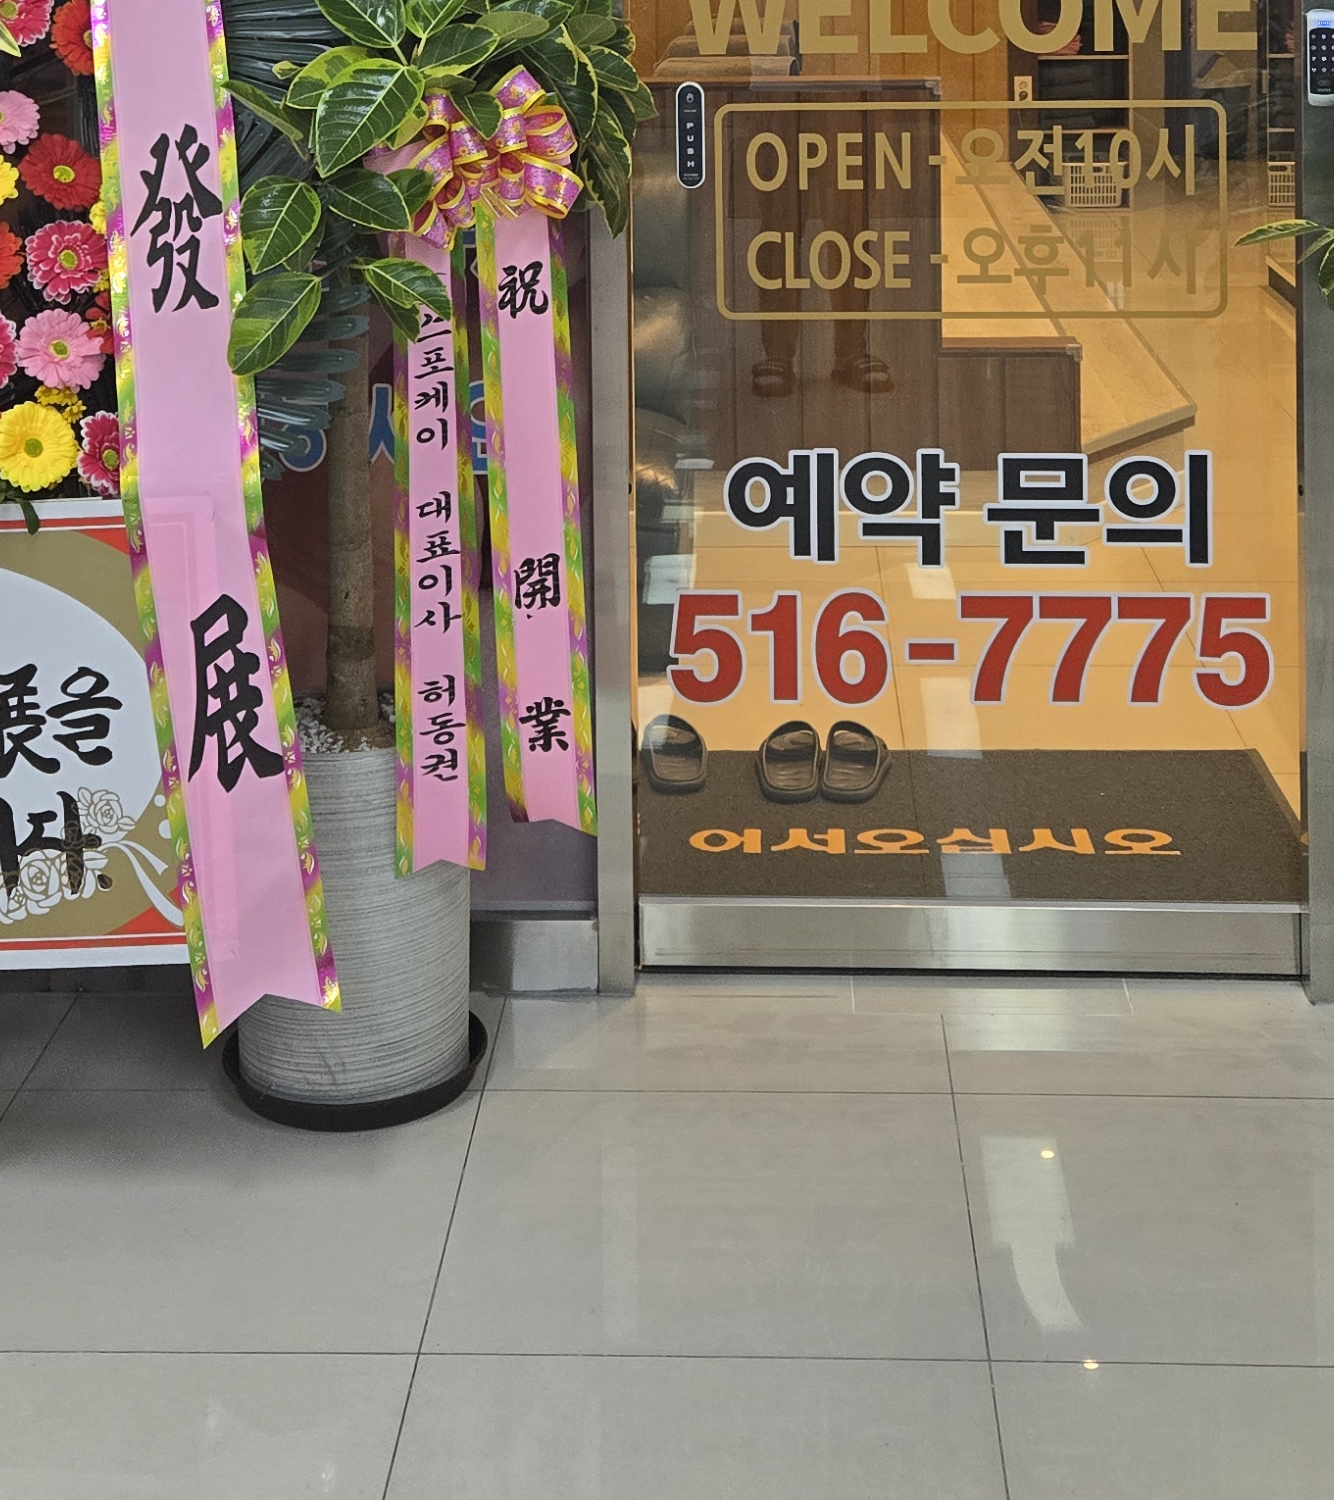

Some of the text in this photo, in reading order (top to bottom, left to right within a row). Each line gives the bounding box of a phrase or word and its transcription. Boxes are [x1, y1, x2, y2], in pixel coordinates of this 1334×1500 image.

[746, 132, 912, 191] OPEN
[955, 124, 1195, 197] 오전10시
[746, 230, 911, 289] CLOSE
[957, 224, 1197, 296] 오후11시
[723, 448, 1213, 566] 예약 문의
[415, 490, 462, 636] 대표이사
[666, 588, 1274, 709] 516-7775
[418, 673, 467, 784] 허동권
[688, 827, 1182, 856] 어서오십시오
